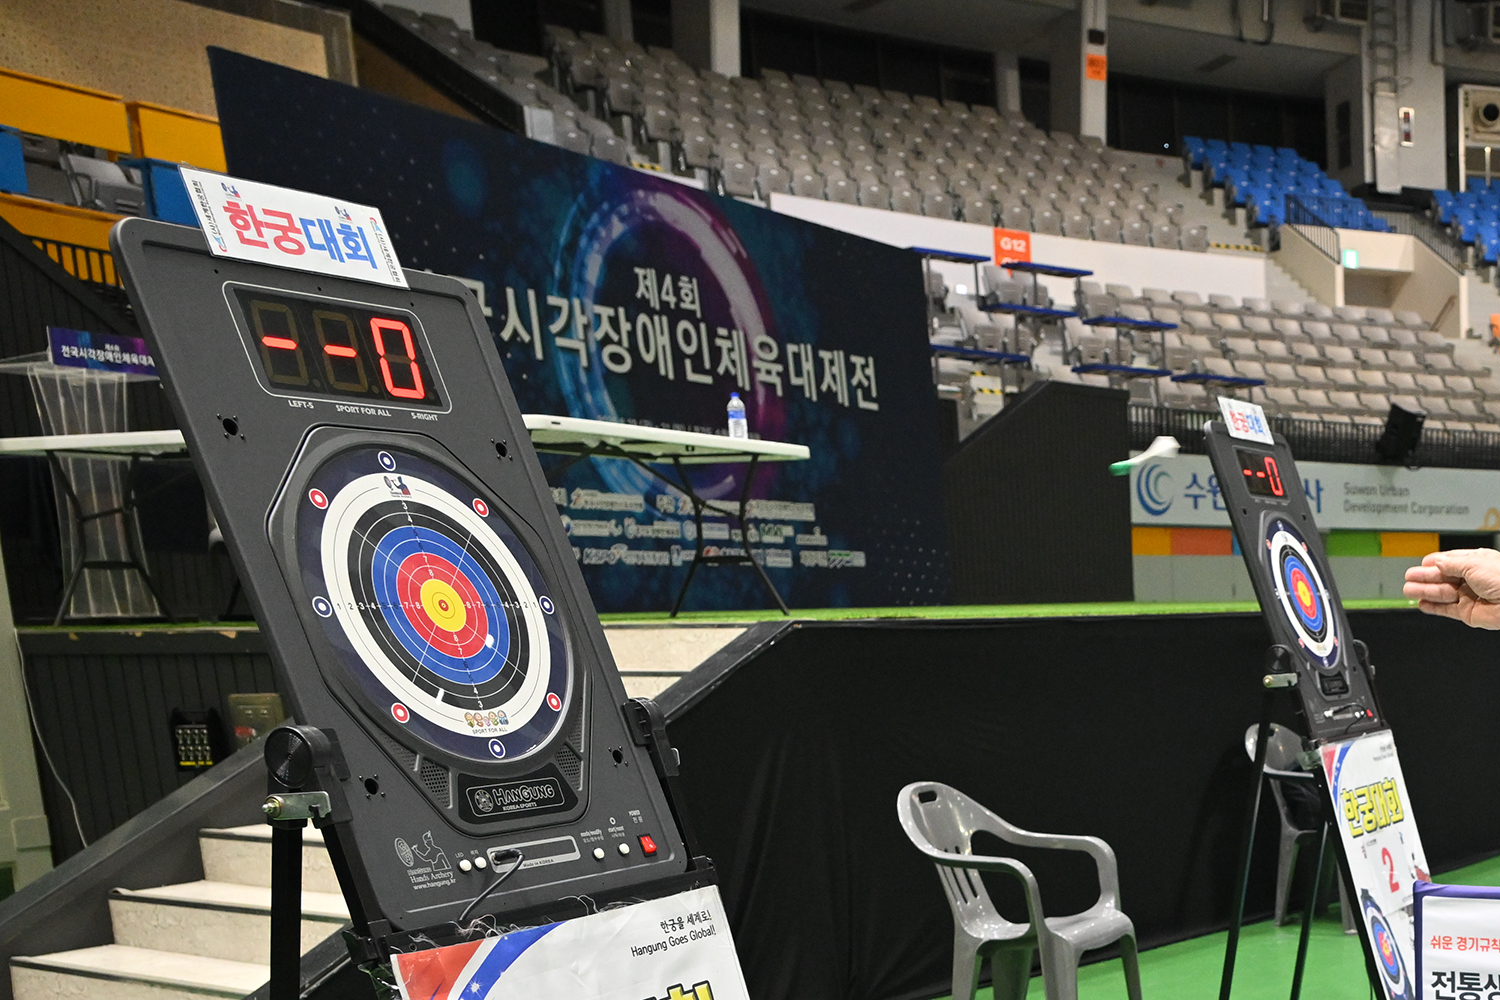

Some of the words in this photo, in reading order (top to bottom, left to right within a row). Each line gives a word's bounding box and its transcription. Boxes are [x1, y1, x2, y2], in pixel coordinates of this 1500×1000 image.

[222, 200, 379, 270] 한궁대회
[634, 266, 702, 318] 제4회
[335, 404, 360, 415] SPORT
[360, 407, 376, 416] FOR
[376, 408, 392, 418] ALL
[1343, 501, 1408, 517] Development
[1409, 503, 1470, 517] Corporation
[1340, 776, 1404, 839] 한궁대회
[1381, 847, 1400, 893] 2
[660, 916, 685, 934] 한궁을
[687, 909, 712, 926] 세계로!
[631, 940, 667, 957] Hangung
[668, 934, 689, 947] Goes
[689, 924, 716, 941] Global!
[1430, 935, 1453, 950] 쉬운
